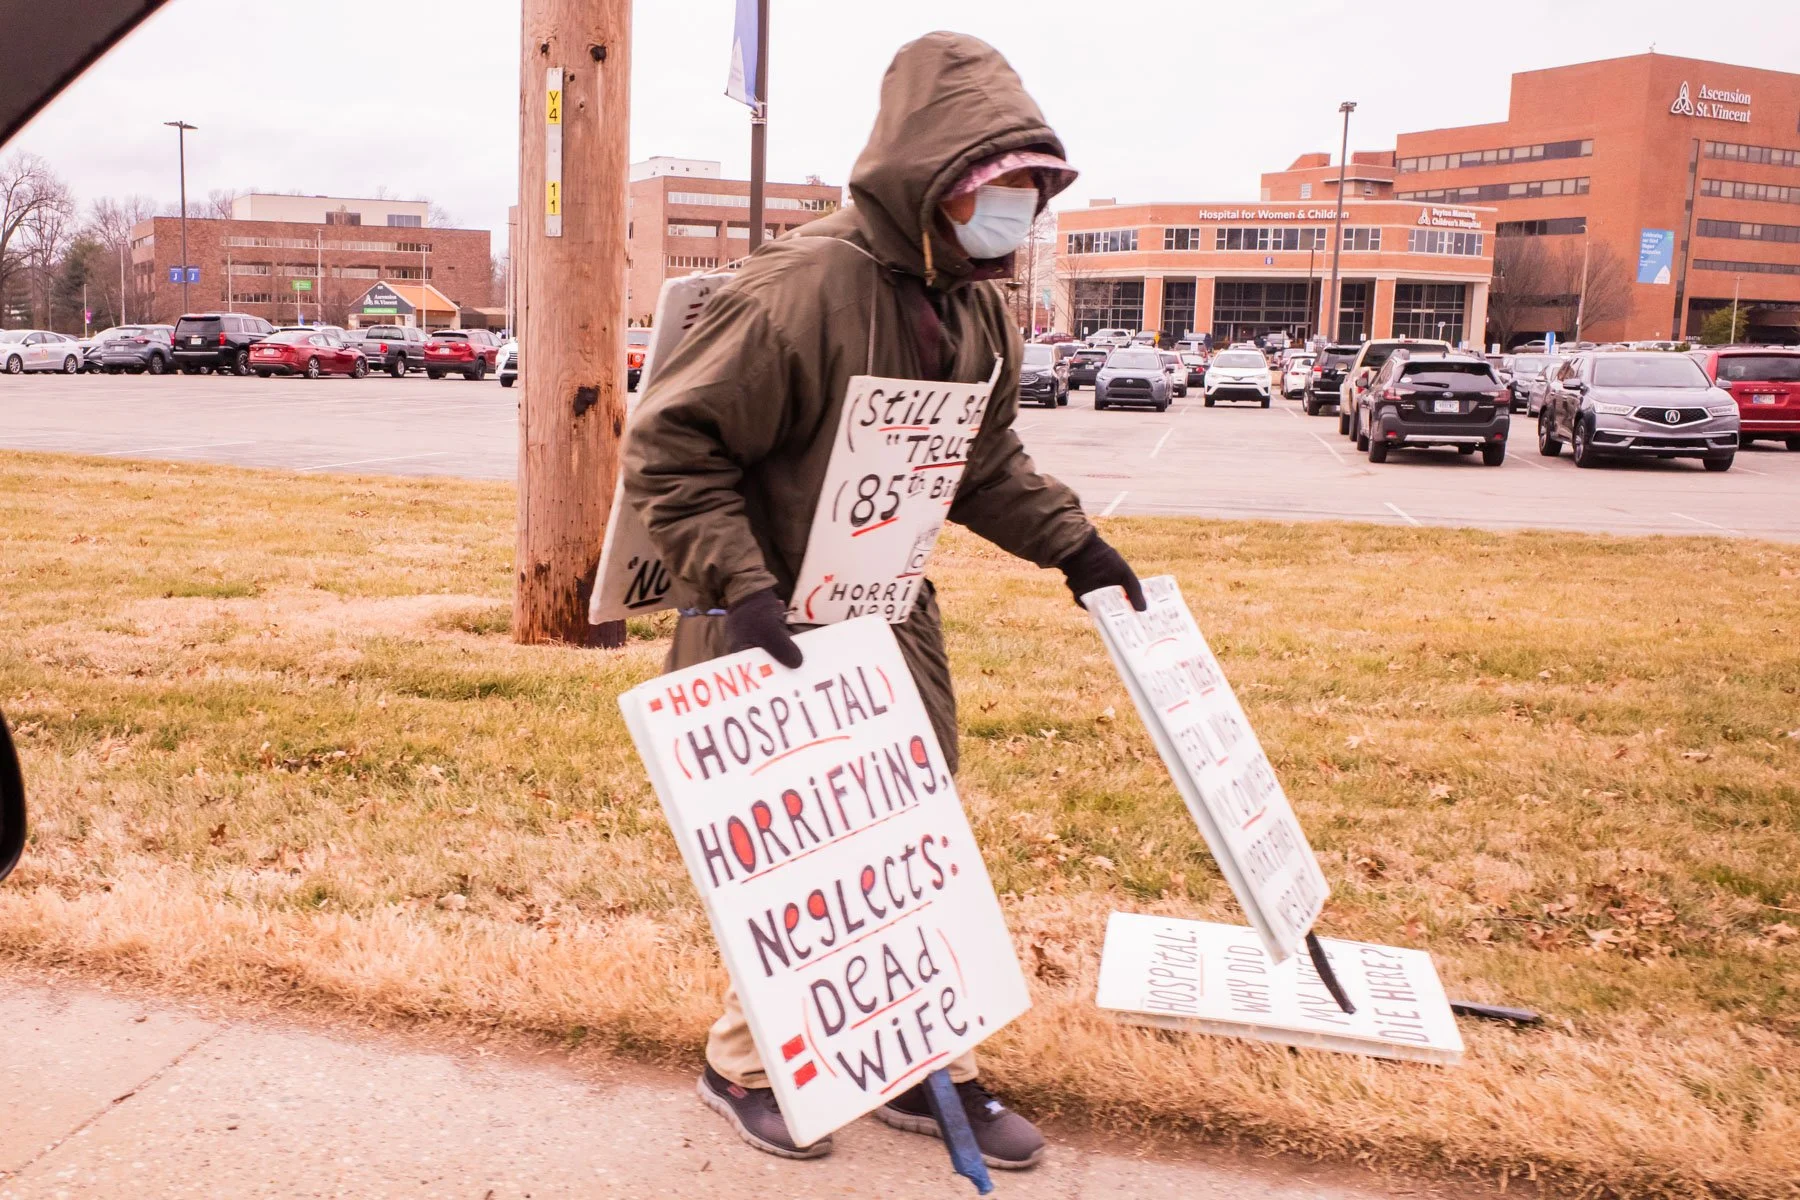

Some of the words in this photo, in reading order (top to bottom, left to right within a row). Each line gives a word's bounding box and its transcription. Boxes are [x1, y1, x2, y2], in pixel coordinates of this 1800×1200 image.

[1698, 84, 1751, 105] Ascension
[1711, 104, 1751, 123] Vincent
[1199, 209, 1239, 221] Hospital
[1241, 209, 1255, 219] for
[1258, 209, 1295, 219] Women
[1297, 209, 1305, 219] &
[1307, 209, 1350, 219] Childrn
[1360, 948, 1417, 1002] HERE?
[1226, 978, 1272, 1014] WHY
